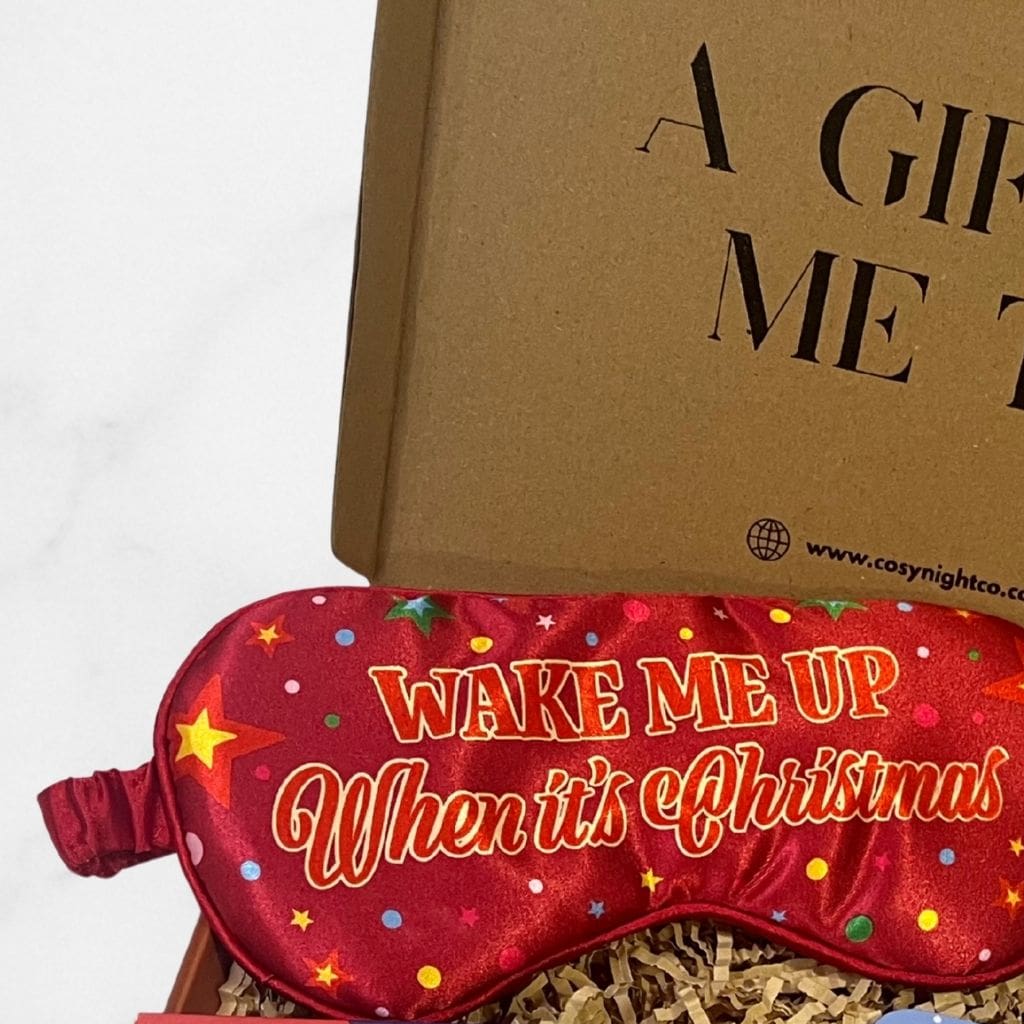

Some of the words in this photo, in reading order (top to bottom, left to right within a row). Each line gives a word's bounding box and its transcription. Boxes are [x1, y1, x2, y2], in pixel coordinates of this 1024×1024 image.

[635, 42, 737, 173] A
[707, 228, 929, 383] ME
[369, 658, 627, 743] WAKE
[638, 652, 778, 737] ME
[783, 645, 899, 722] UP
[272, 757, 528, 891] When
[533, 754, 633, 855] it's
[639, 742, 1010, 857] Christmas
